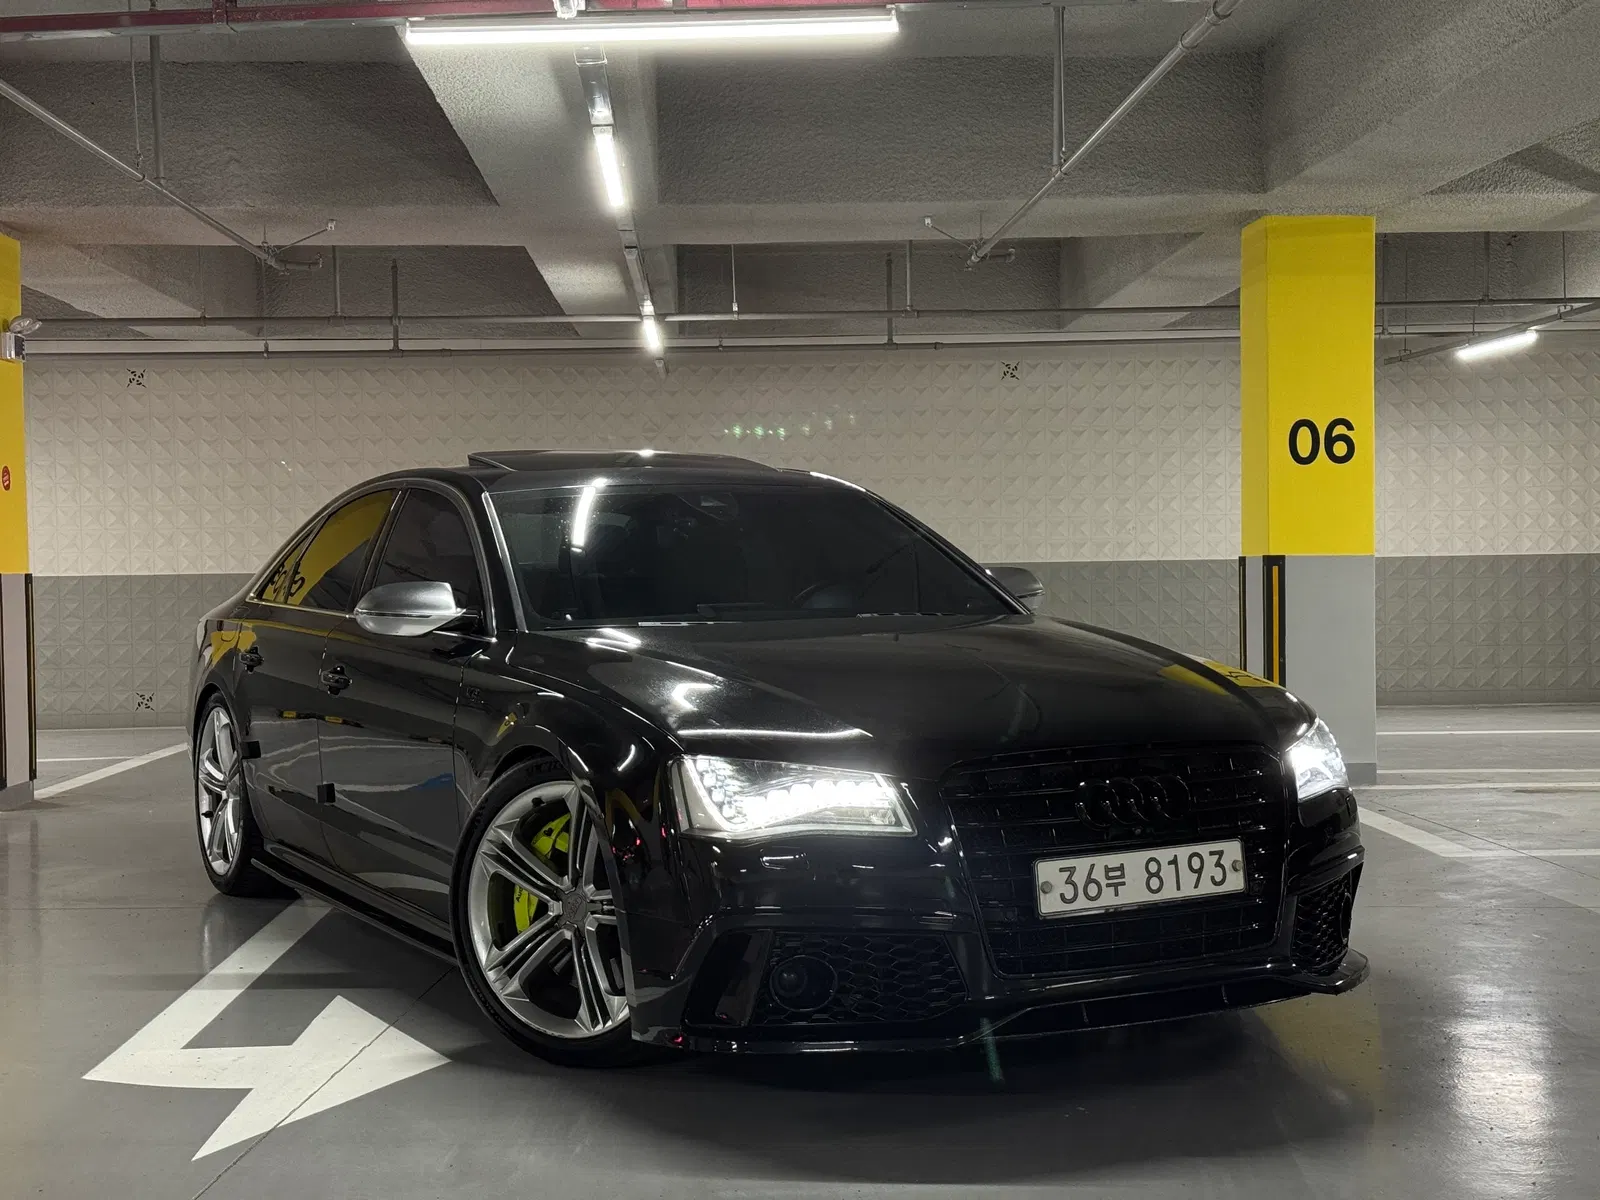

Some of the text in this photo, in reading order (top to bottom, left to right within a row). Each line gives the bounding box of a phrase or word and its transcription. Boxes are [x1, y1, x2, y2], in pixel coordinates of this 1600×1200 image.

[1288, 418, 1356, 465] 06
[1058, 849, 1228, 904] 36부 8193
